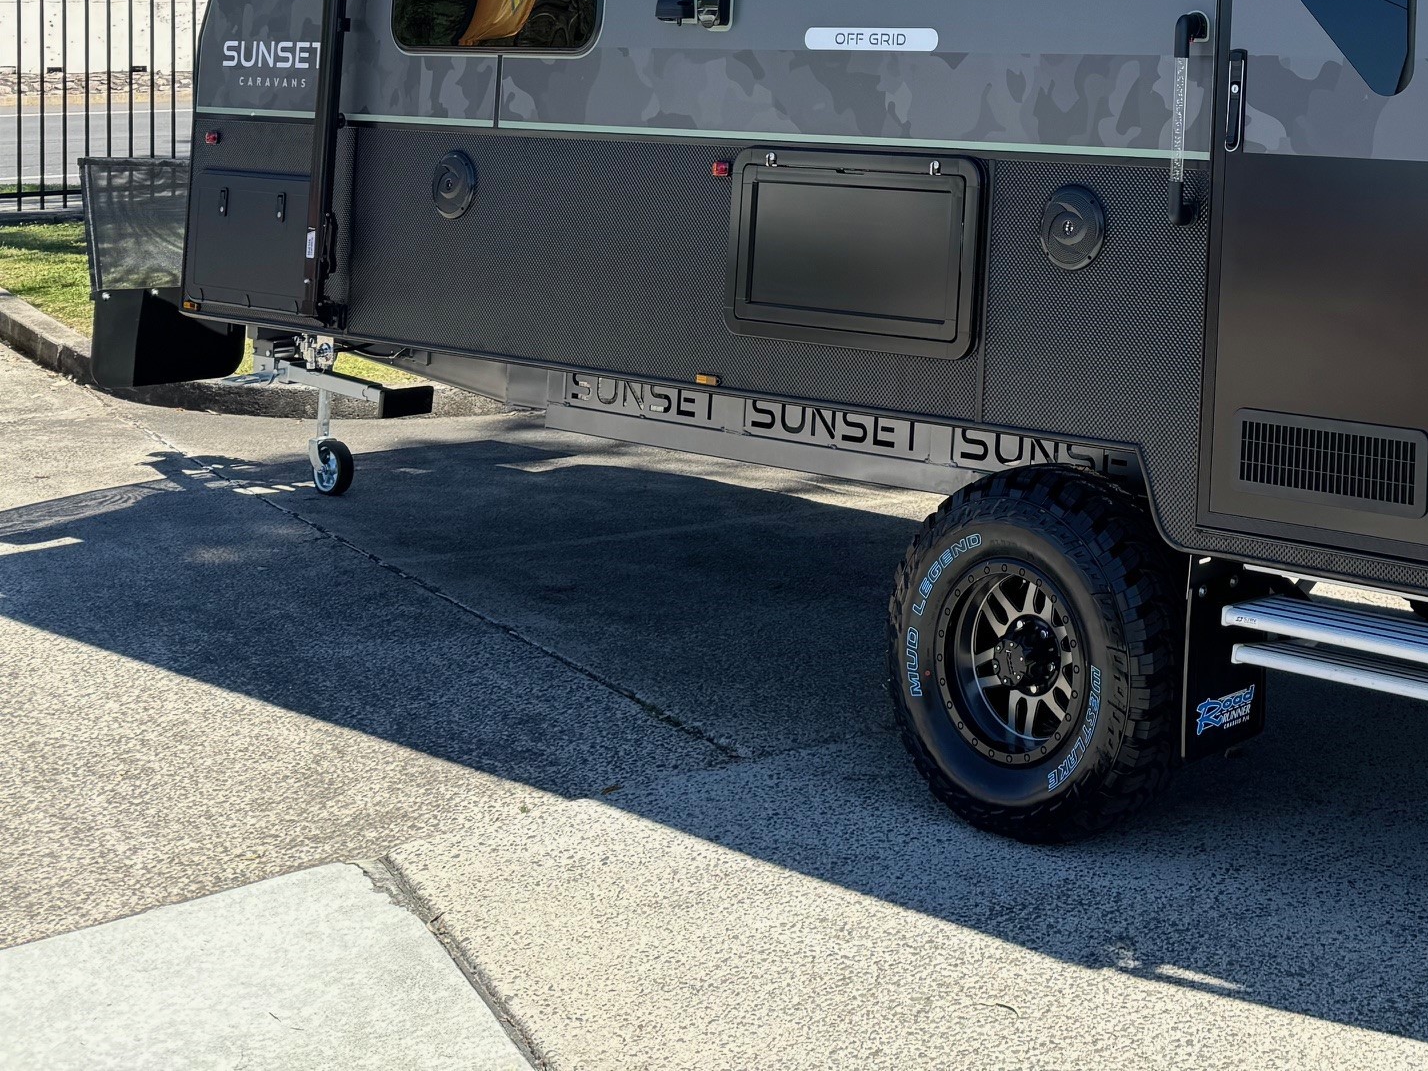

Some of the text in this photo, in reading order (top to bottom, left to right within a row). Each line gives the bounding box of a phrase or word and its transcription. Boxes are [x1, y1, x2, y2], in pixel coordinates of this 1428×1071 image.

[834, 32, 907, 46] OFF GRID
[222, 40, 321, 69] SUNSET
[239, 76, 307, 88] CARAVANS
[908, 533, 982, 697] MUD LEGEND
[1196, 683, 1255, 736] Road
[1221, 704, 1252, 724] RUNNER
[1047, 664, 1101, 792] WESTLAKE
